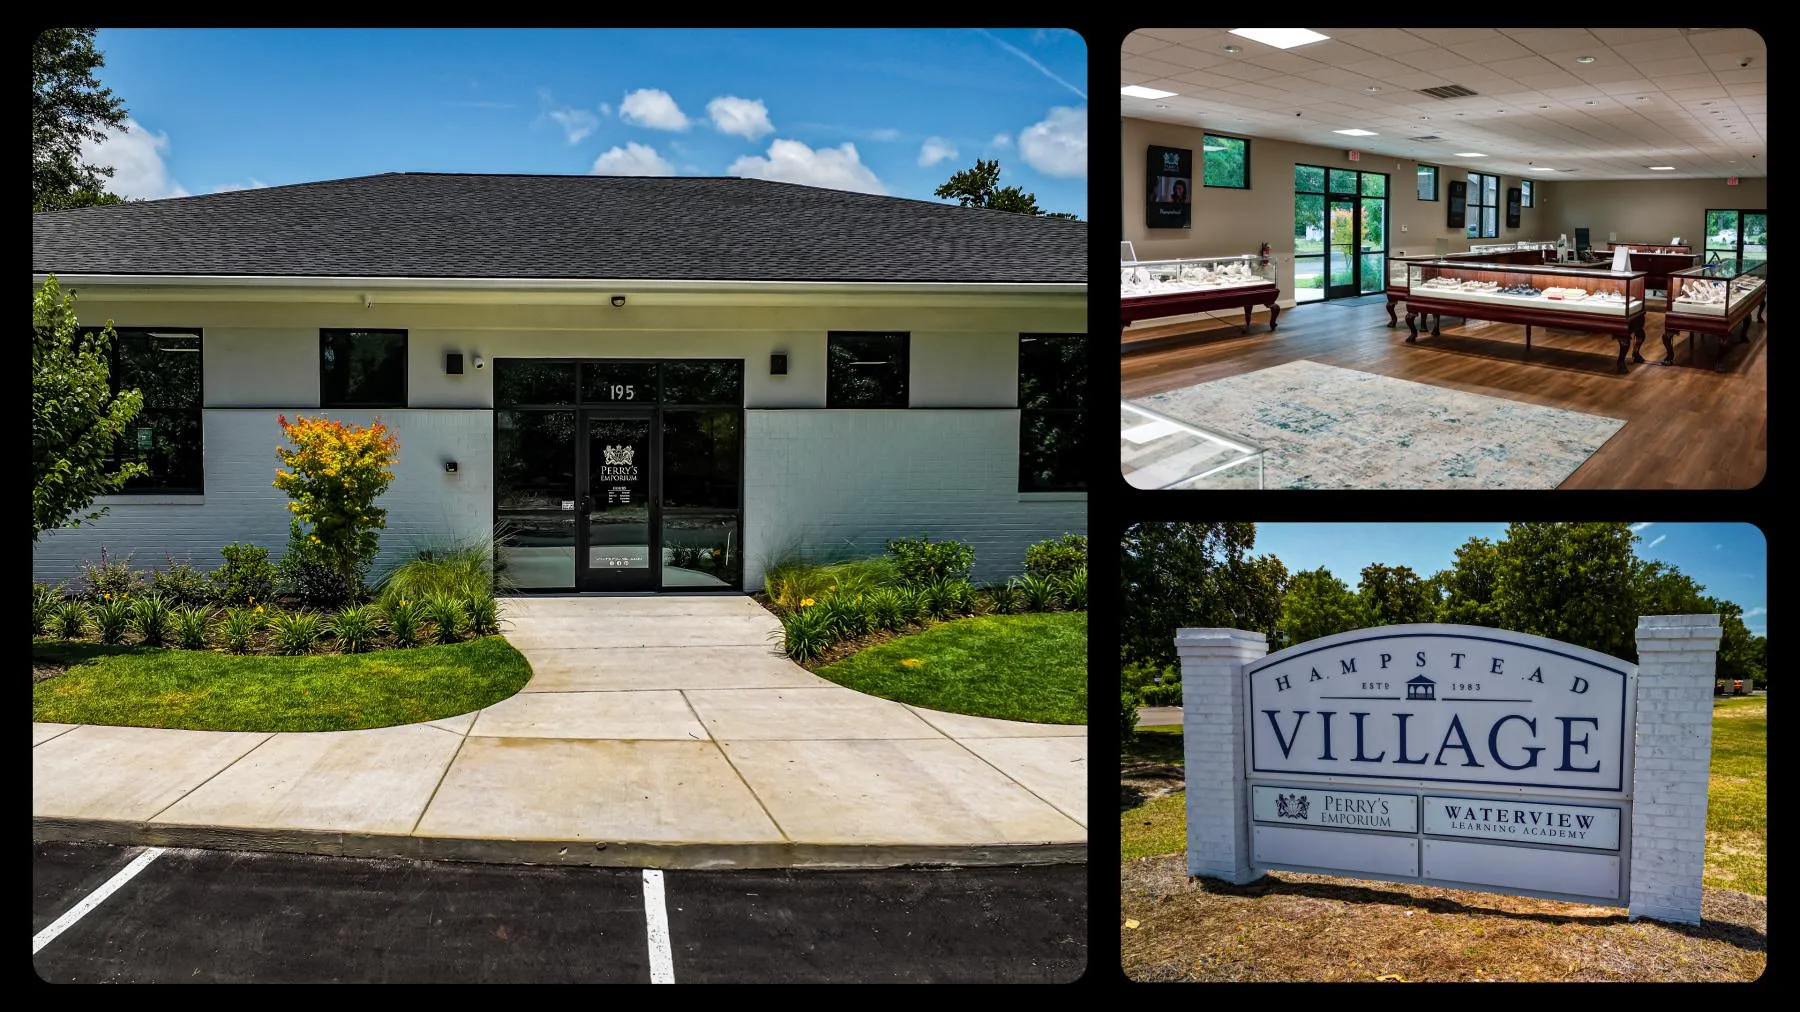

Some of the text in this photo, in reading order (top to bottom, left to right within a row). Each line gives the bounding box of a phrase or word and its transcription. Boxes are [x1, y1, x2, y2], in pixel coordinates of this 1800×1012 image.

[610, 385, 635, 400] 195
[601, 465, 638, 475] PERRY'S
[1275, 651, 1590, 695] HAMPSTEAD
[1451, 683, 1481, 691] 1983
[1260, 709, 1601, 773] VILLAGE
[1324, 795, 1389, 815] PERRY'S
[1320, 812, 1391, 828] EMPORIUM
[1444, 804, 1595, 830] WATERVIEW
[1451, 821, 1587, 840] LEARNING ACADEMY
